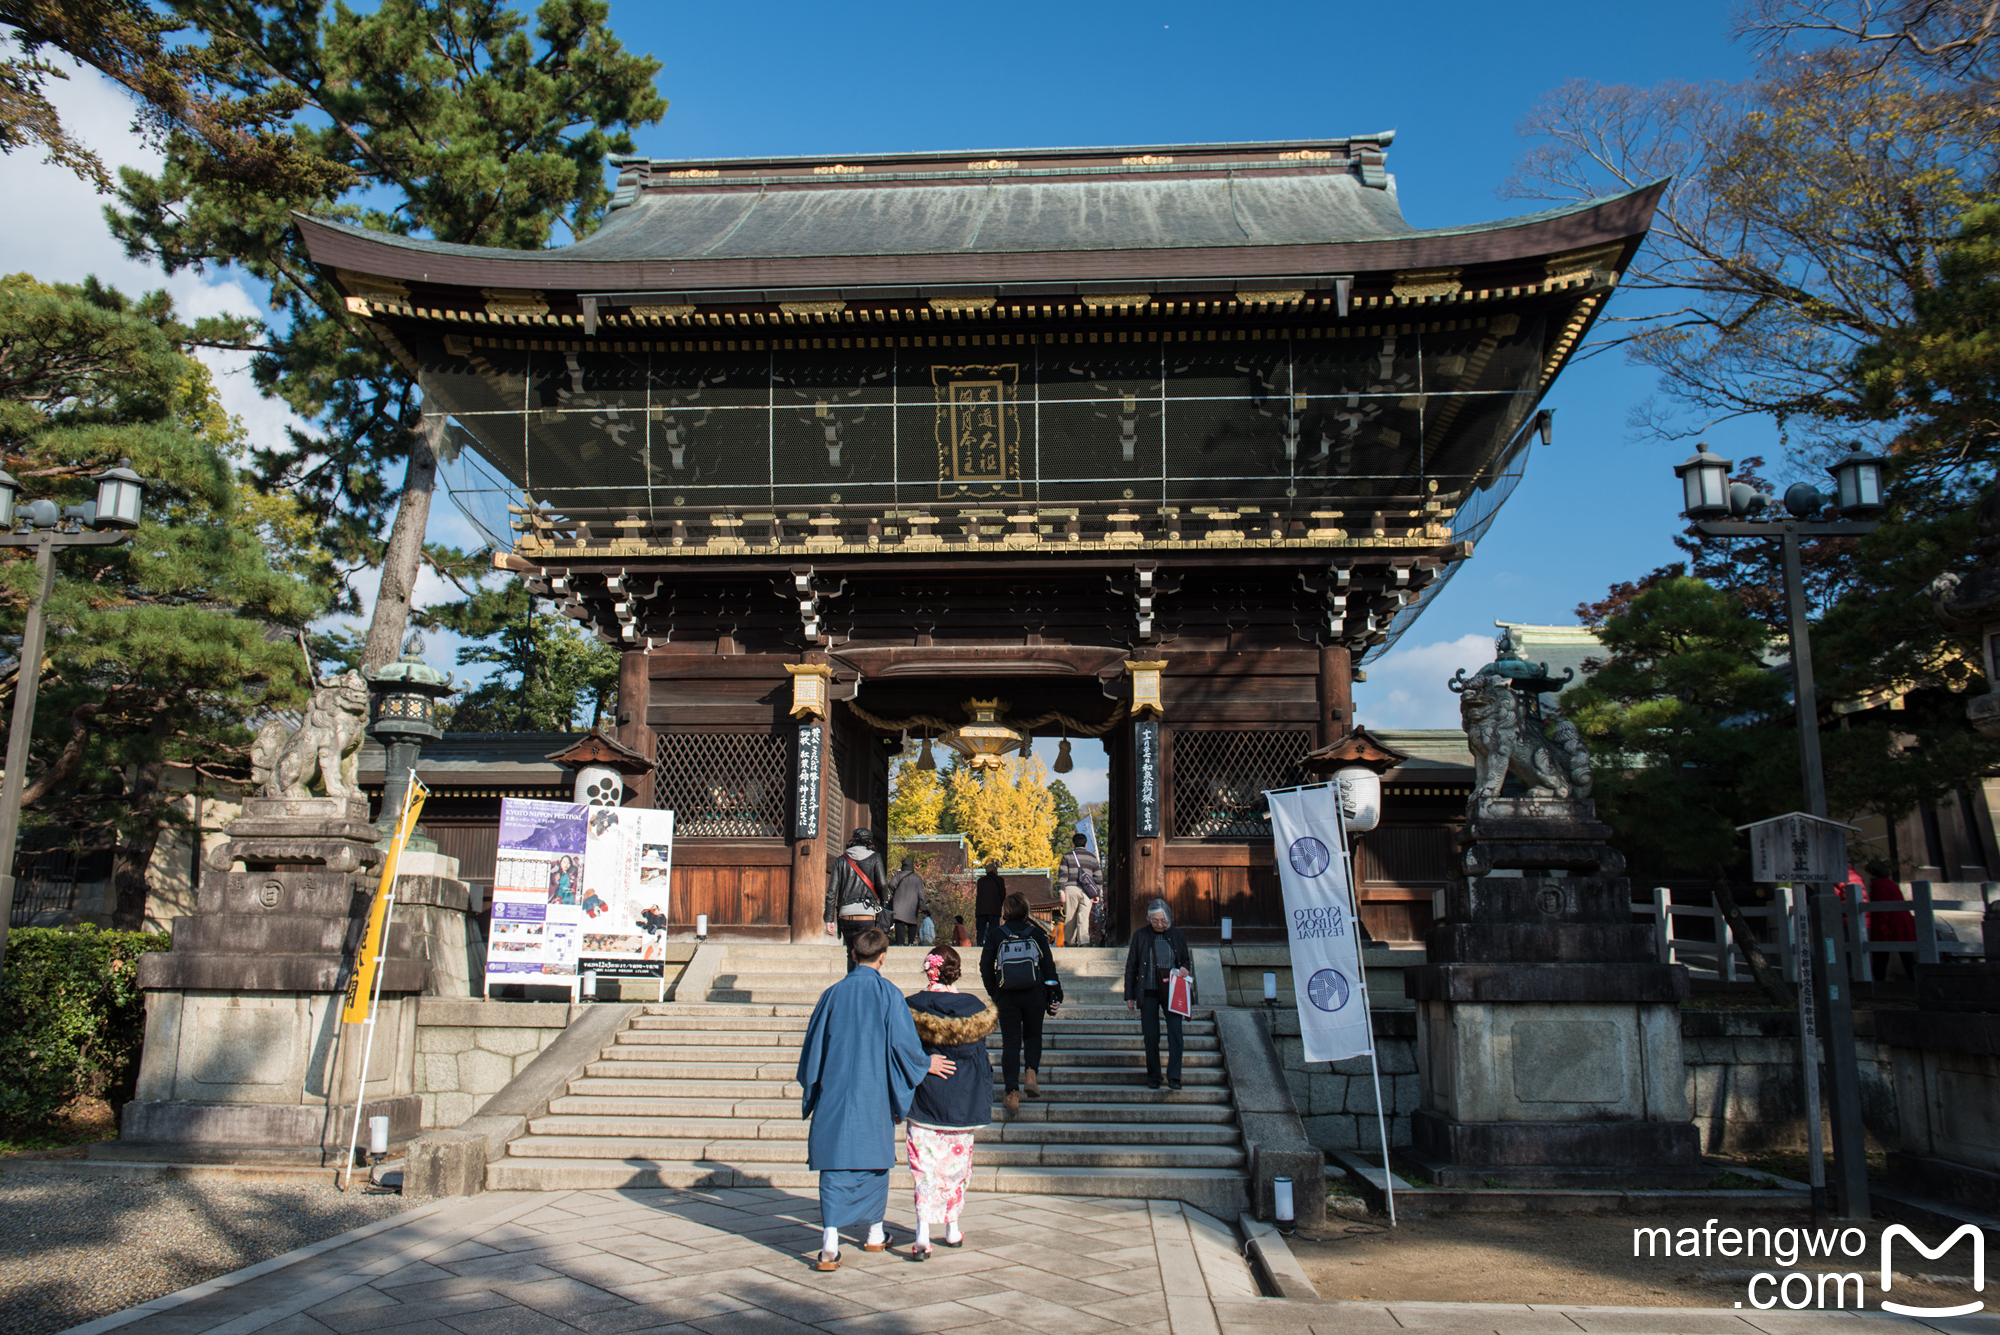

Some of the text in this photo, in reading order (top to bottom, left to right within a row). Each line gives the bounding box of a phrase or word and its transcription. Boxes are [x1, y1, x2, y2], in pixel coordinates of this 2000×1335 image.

[505, 809, 528, 817] KYOTO
[529, 811, 553, 819] NIPPON
[1791, 839, 1810, 871] 禁止
[1775, 873, 1828, 881] NO SMOKING
